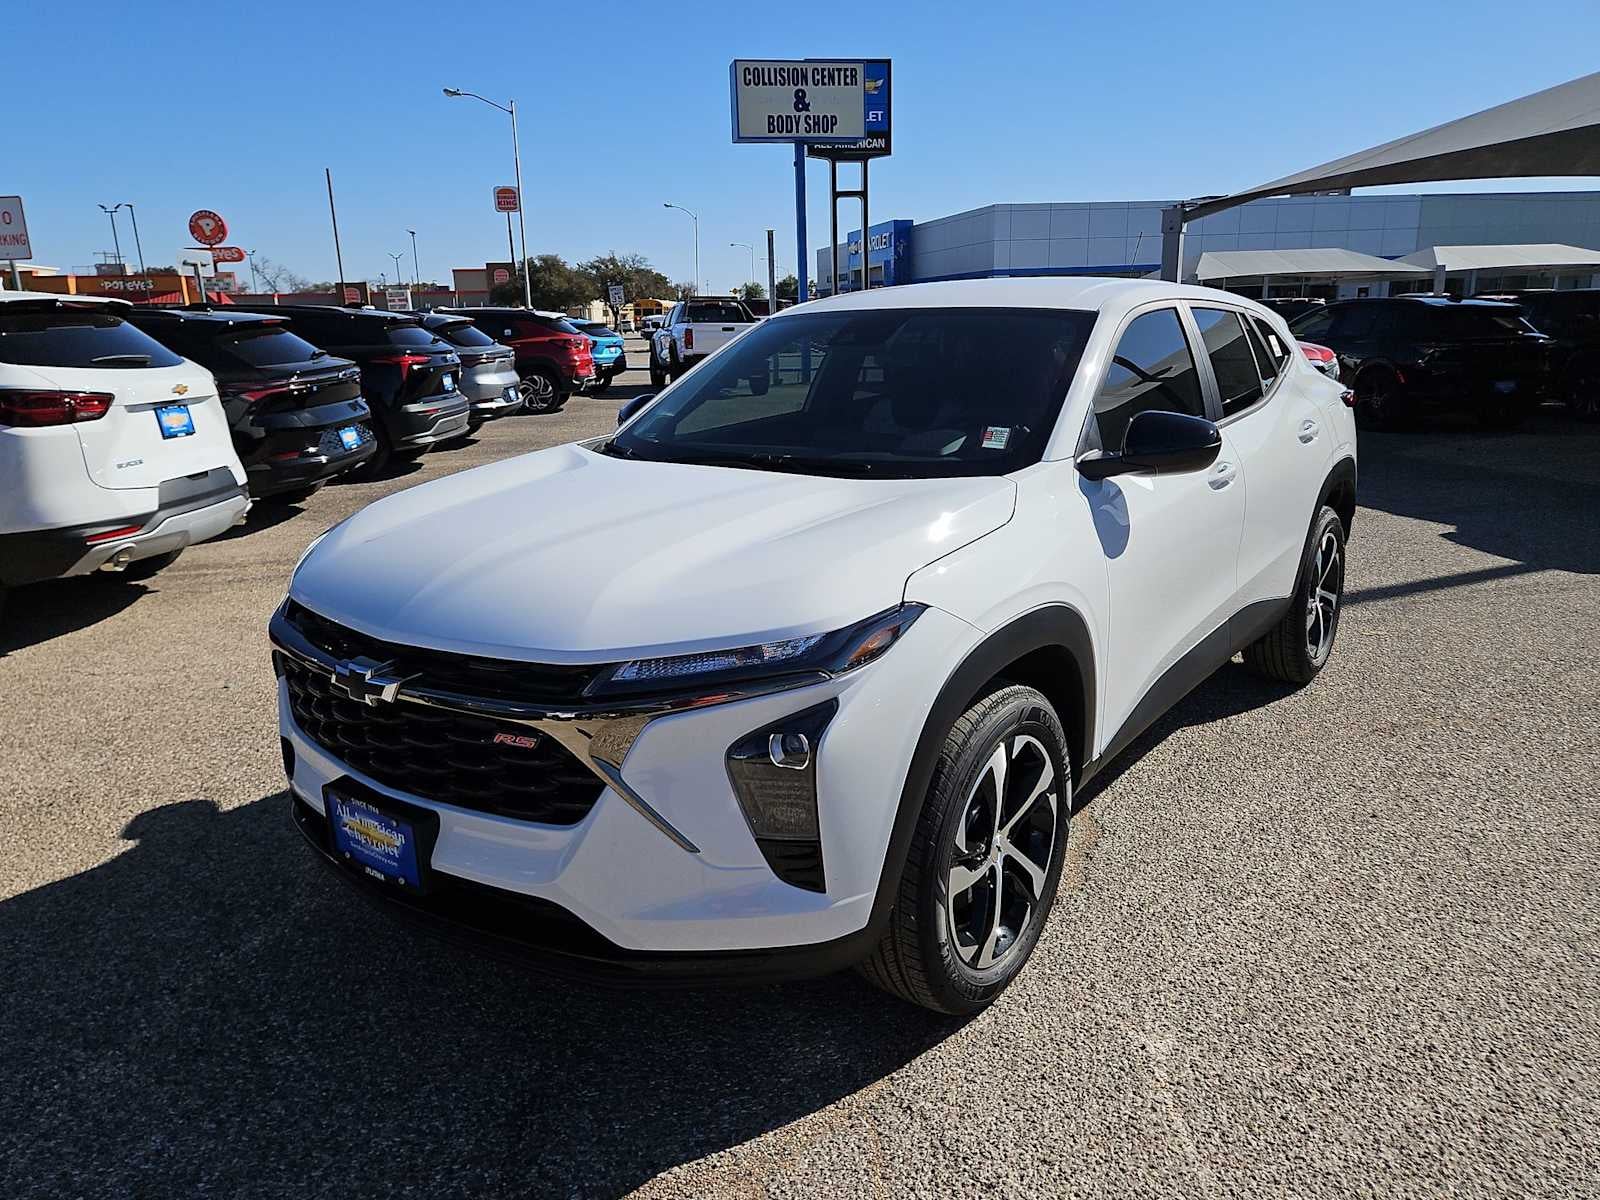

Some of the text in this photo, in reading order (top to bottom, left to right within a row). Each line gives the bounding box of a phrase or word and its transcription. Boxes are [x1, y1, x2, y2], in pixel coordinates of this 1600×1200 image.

[743, 66, 858, 87] COLLISION CENTER
[793, 88, 811, 113] &
[767, 114, 838, 134] BODY SHOP
[493, 733, 536, 749] RS
[336, 803, 350, 817] All
[353, 812, 406, 844] American
